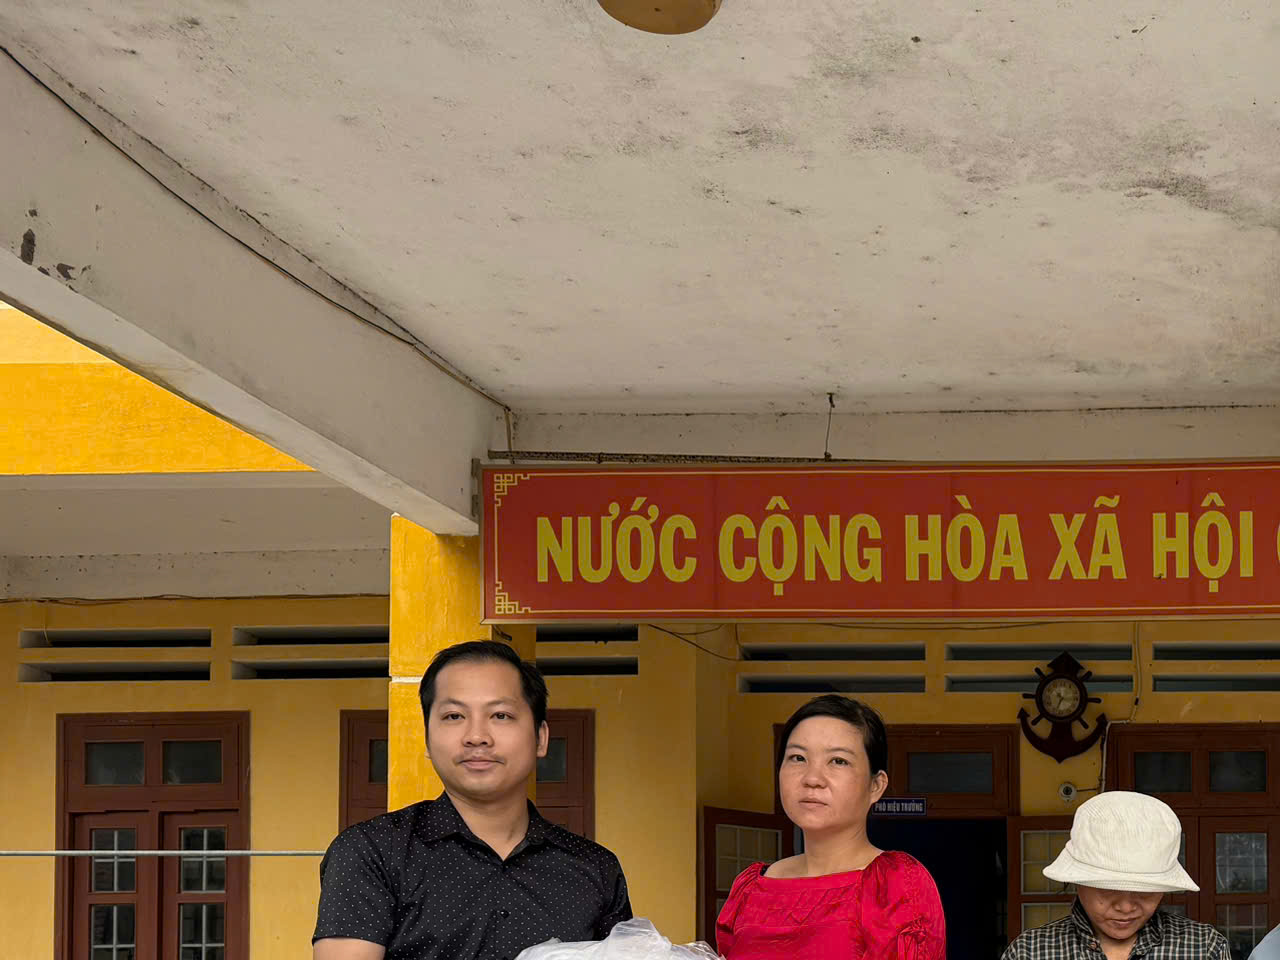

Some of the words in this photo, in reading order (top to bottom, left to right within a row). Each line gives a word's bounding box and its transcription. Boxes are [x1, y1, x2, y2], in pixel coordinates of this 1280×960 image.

[536, 496, 698, 583] NƯỚC
[718, 495, 883, 597] CỘNG
[904, 495, 1029, 582] HÒA
[1048, 494, 1128, 580] XÃ
[1152, 492, 1254, 593] HỘI
